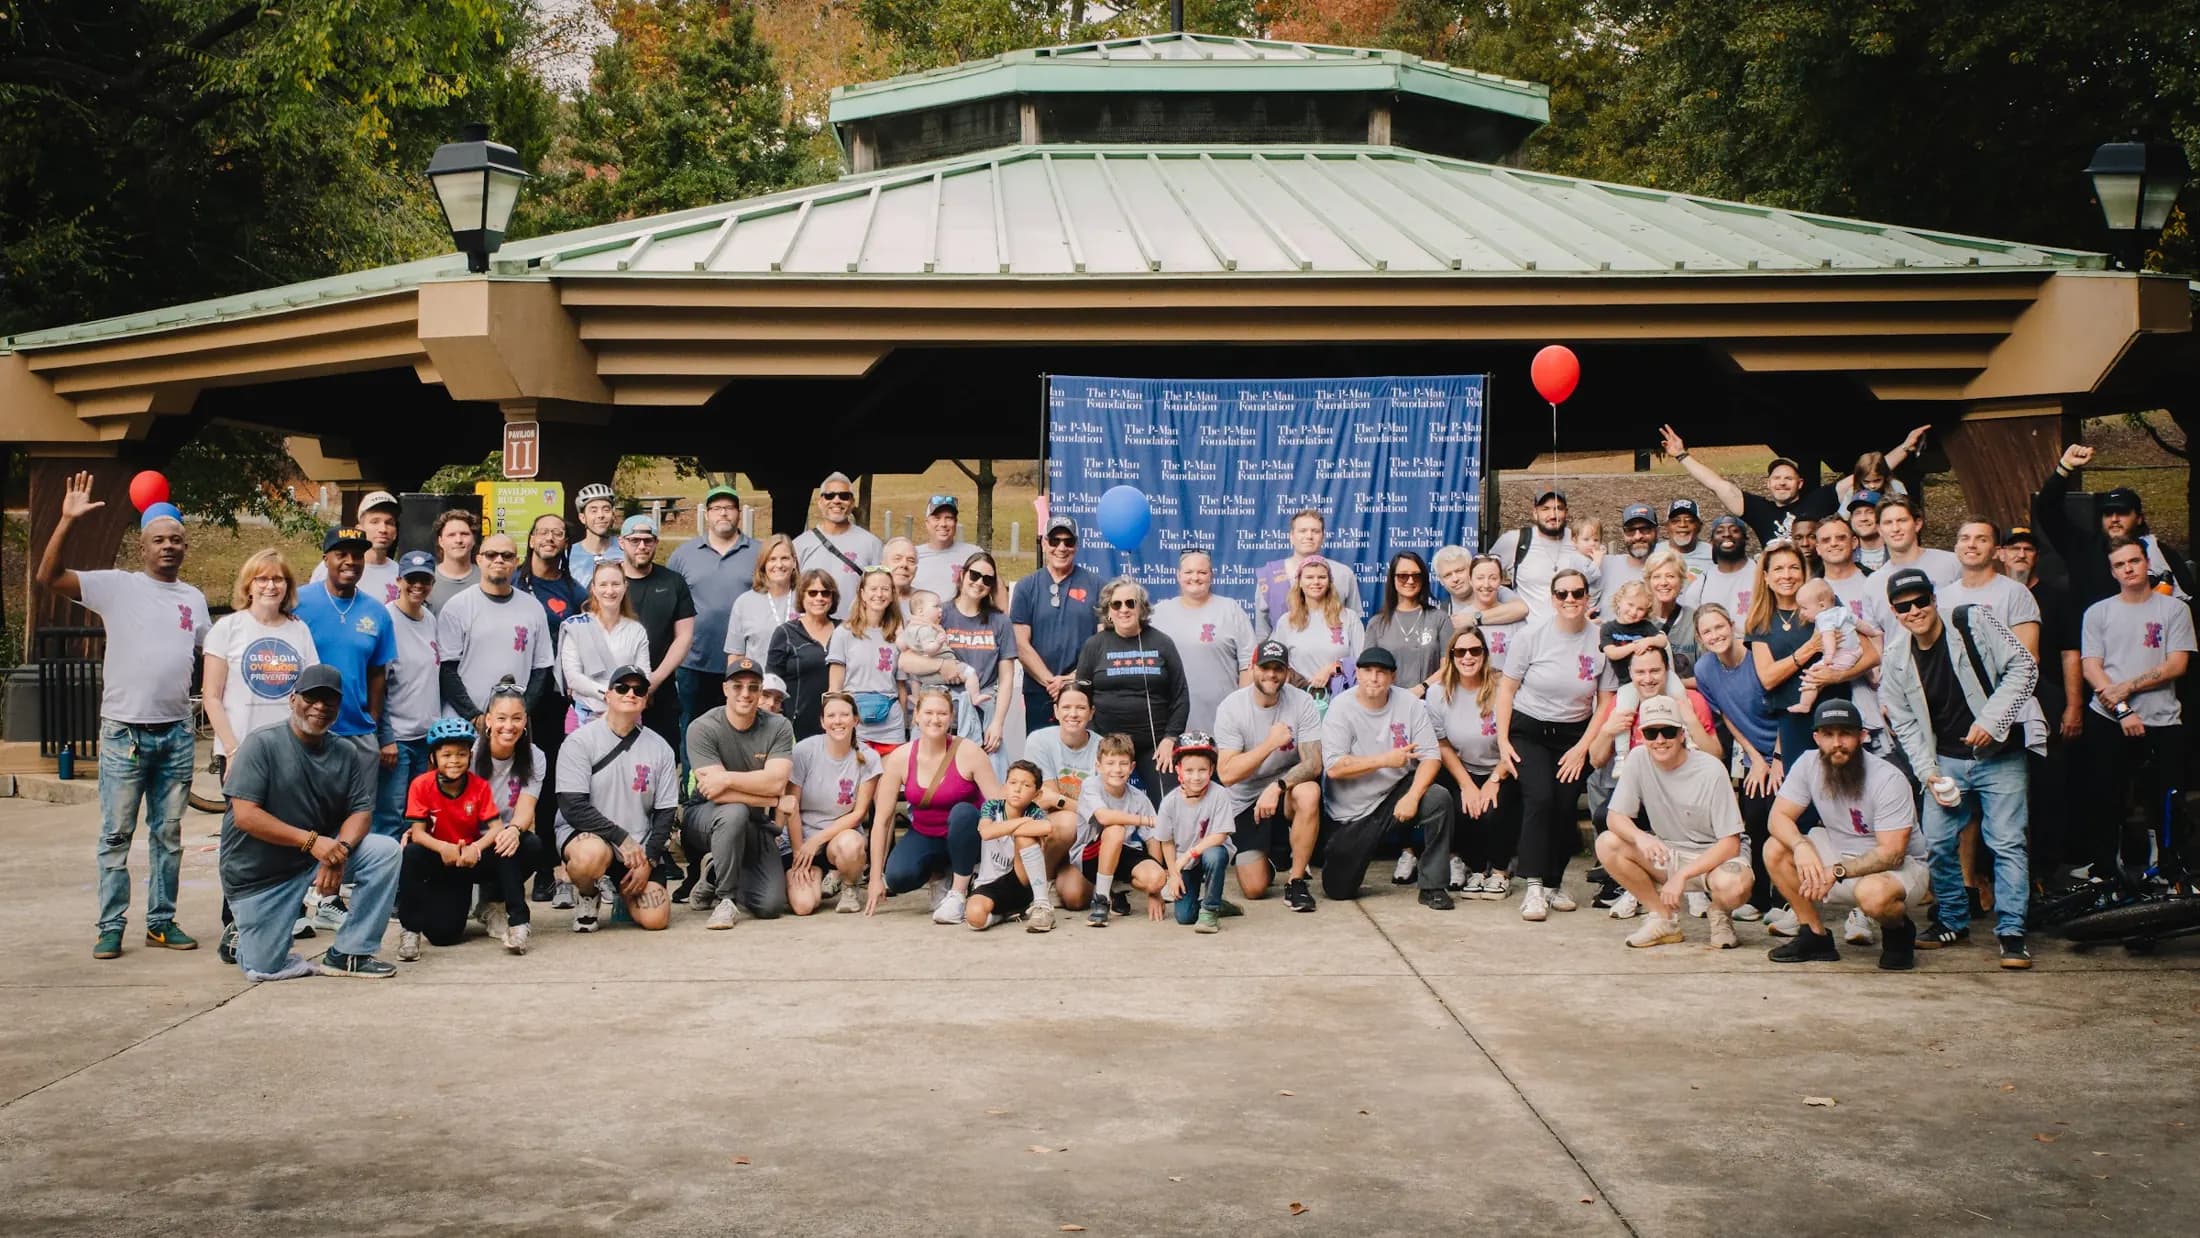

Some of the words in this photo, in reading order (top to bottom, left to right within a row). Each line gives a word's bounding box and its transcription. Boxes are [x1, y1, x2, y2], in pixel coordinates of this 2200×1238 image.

[1086, 387, 1106, 398] The
[1110, 388, 1142, 400] P-Man
[1163, 390, 1182, 401] The
[1185, 391, 1217, 401] P-Man
[1238, 390, 1258, 401] The
[1262, 391, 1294, 401] P-Man
[1315, 390, 1335, 400] The
[1338, 388, 1370, 399] P-Man
[1391, 387, 1410, 398] The
[1413, 387, 1445, 398] P-Man
[1086, 398, 1142, 410] Foundation
[1163, 401, 1217, 411] Foundation
[1239, 401, 1294, 411] Foundation
[1316, 399, 1370, 411] Foundation
[1391, 398, 1445, 408] Foundation
[1070, 422, 1102, 433] P-Man
[1125, 423, 1144, 434] The
[1148, 424, 1178, 435] P-Man
[1200, 425, 1220, 435] The
[1224, 425, 1256, 435] P-Man
[1277, 424, 1297, 435] The
[1301, 424, 1333, 435] P-Man
[1354, 423, 1374, 433] The
[1377, 422, 1408, 433] P-Man
[1429, 422, 1447, 432] The
[1451, 422, 1482, 432] P-Man
[508, 429, 535, 439] PAVILION
[1354, 432, 1408, 444] Foundation
[1430, 432, 1482, 443] Foundation
[1125, 434, 1178, 446] Foundation
[1200, 435, 1256, 446] Foundation
[1278, 435, 1333, 446] Foundation
[1084, 457, 1104, 468] The
[1108, 458, 1140, 469] P-Man
[1161, 459, 1180, 470] The
[1183, 460, 1216, 470] P-Man
[1237, 460, 1258, 470] The
[1261, 460, 1294, 470] P-Man
[1315, 458, 1335, 469] The
[1338, 458, 1371, 469] P-Man
[1389, 457, 1409, 467] The
[1413, 457, 1445, 468] P-Man
[1084, 468, 1140, 480] Foundation
[1161, 470, 1216, 481] Foundation
[1238, 470, 1294, 481] Foundation
[1316, 468, 1371, 480] Foundation
[1390, 467, 1444, 478] Foundation
[497, 487, 538, 496] PAVILION
[1354, 492, 1373, 503] The
[1377, 491, 1408, 503] P-Man
[1429, 491, 1447, 502] The
[1450, 491, 1480, 502] P-Man
[1198, 494, 1219, 505] The
[1223, 495, 1255, 505] P-Man
[1277, 494, 1297, 504] The
[1301, 494, 1333, 504] P-Man
[1199, 505, 1255, 516] Foundation
[1355, 502, 1408, 513] Foundation
[1430, 502, 1480, 513] Foundation
[338, 529, 362, 538] NAVY
[1159, 529, 1179, 540] The
[1183, 530, 1215, 540] P-Man
[1236, 529, 1257, 540] The
[1338, 527, 1370, 538] P-Man
[1389, 526, 1408, 537] The
[1413, 526, 1442, 537] P-Man
[1160, 540, 1215, 550] Foundation
[1390, 537, 1442, 548] Foundation
[1120, 563, 1140, 574] The
[1144, 564, 1176, 574] P-Man
[1222, 565, 1254, 575] P-Man
[1354, 562, 1373, 573] The
[249, 654, 298, 662] GEORGIA
[250, 673, 298, 681] PREVENTION
